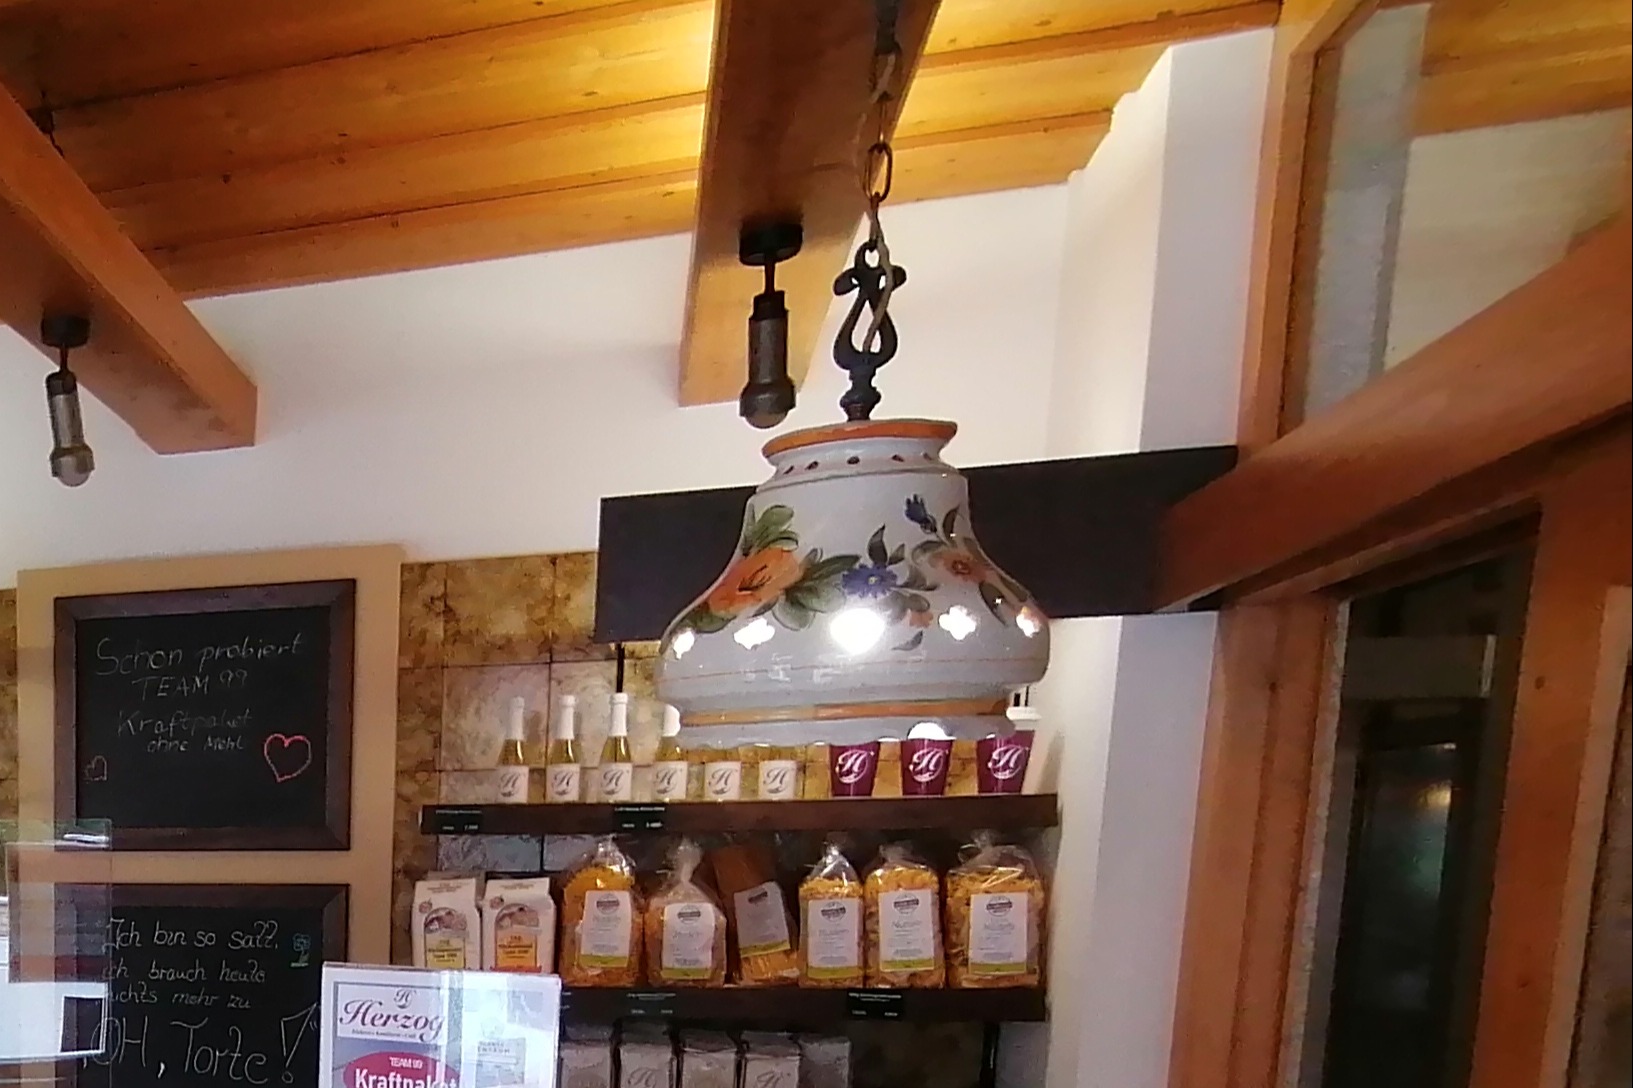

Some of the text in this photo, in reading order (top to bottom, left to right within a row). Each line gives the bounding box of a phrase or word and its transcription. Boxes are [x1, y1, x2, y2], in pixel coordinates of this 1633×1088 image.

[96, 632, 303, 676] Schon probiert
[132, 675, 210, 701] TEAM
[147, 736, 188, 753] ohne
[154, 920, 187, 946] bin
[194, 930, 216, 948] so
[148, 959, 207, 982] brauch
[172, 987, 218, 1006] mehr
[227, 994, 251, 1009] zu
[339, 999, 446, 1043] Herzog
[389, 1056, 412, 1068] TEAM
